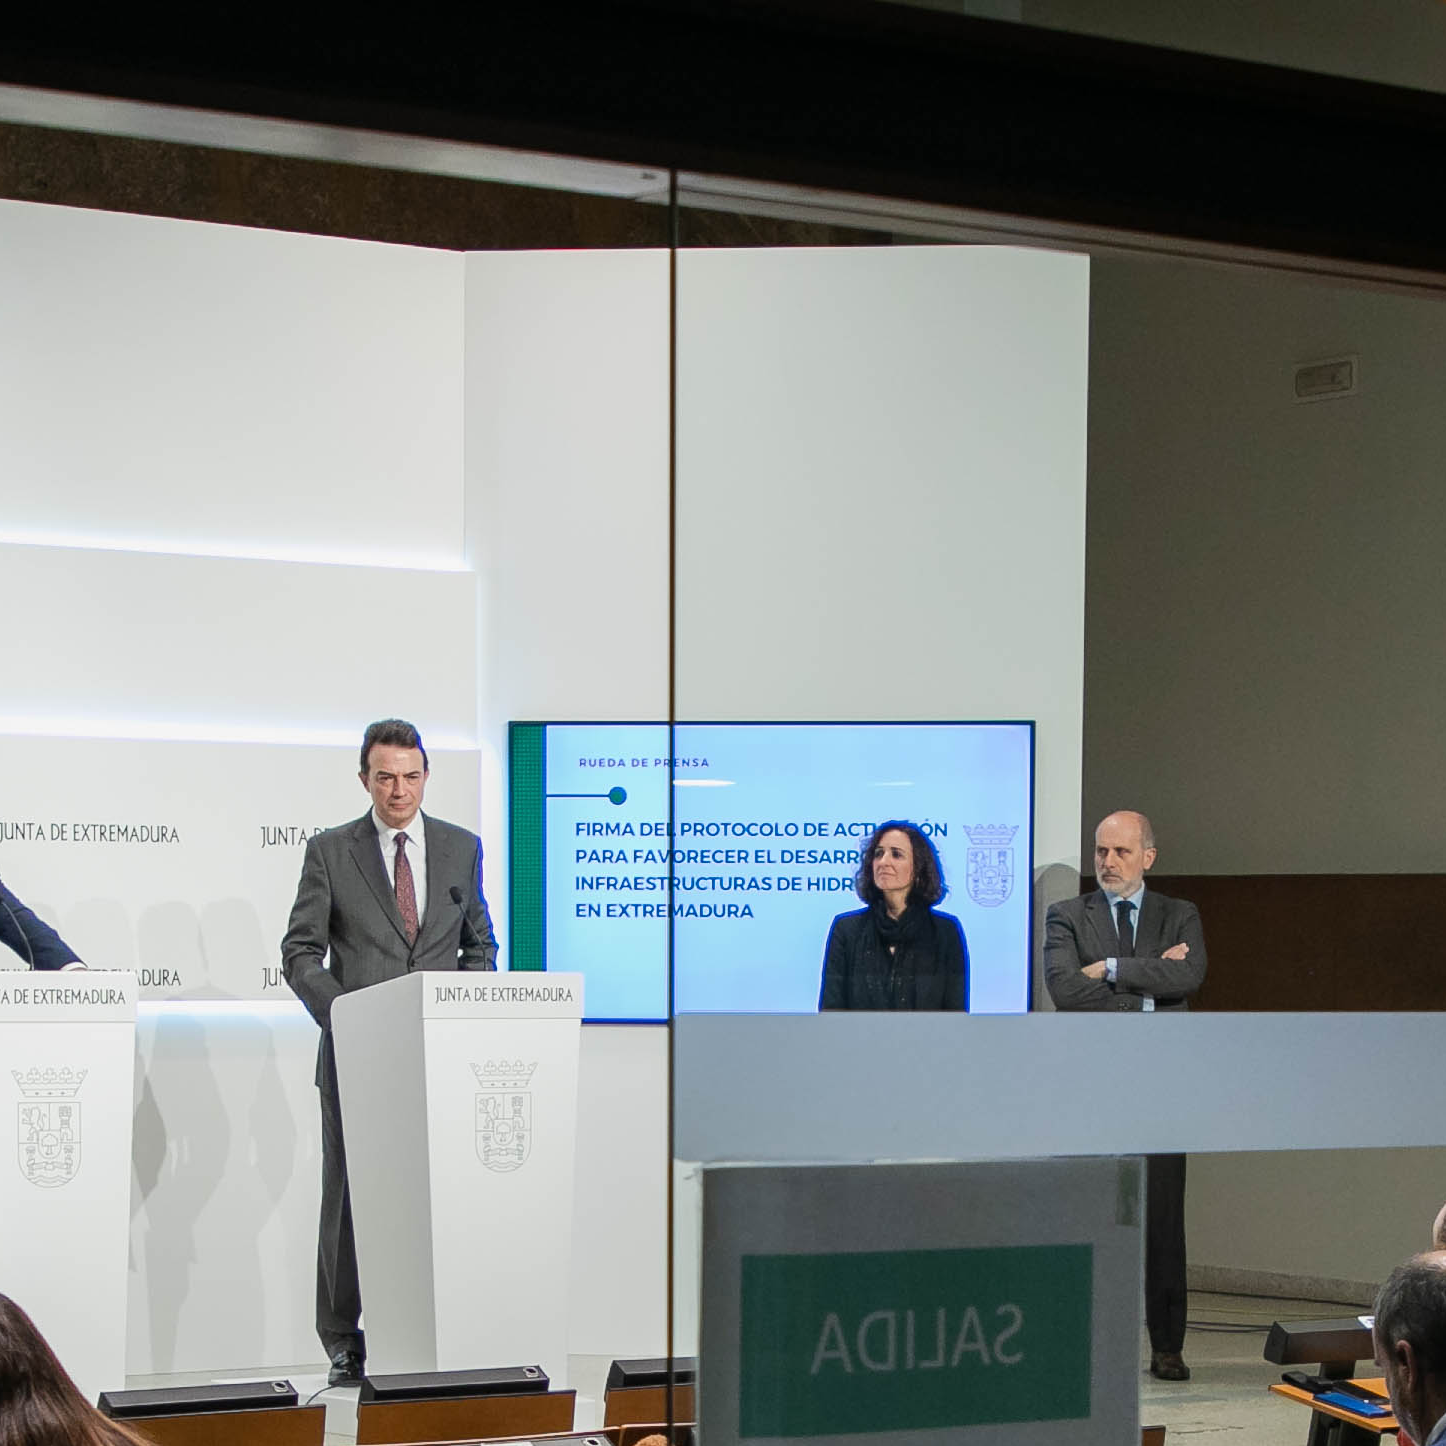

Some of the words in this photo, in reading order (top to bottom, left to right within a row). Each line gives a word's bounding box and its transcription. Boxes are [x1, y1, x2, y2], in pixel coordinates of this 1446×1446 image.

[579, 758, 626, 767] RUEDA
[631, 758, 648, 767] DE
[655, 758, 709, 767] PRENSA
[51, 823, 68, 841] DE
[73, 824, 180, 843] EXTREMADURA
[575, 822, 635, 836] FIRMA
[640, 822, 676, 836] DEL
[681, 822, 799, 836] PROTOCOLO
[803, 822, 829, 836] DE
[833, 818, 948, 837] ACTÓN
[261, 826, 308, 848] JUNTA
[575, 849, 628, 863] PARA
[633, 849, 749, 864] FAVORECER
[755, 849, 776, 863] EL
[781, 849, 860, 864] DESARR
[575, 876, 772, 891] INFRAESTRUCTURAS
[777, 877, 802, 891] DE
[575, 904, 601, 918] EN
[606, 904, 754, 918] EXTREMADURA
[14, 989, 29, 1004] DE
[33, 989, 126, 1005] EXTREMADURA
[435, 987, 471, 1004] JUNTA
[474, 987, 488, 1001] DE
[491, 987, 574, 1002] EXTREMADURA
